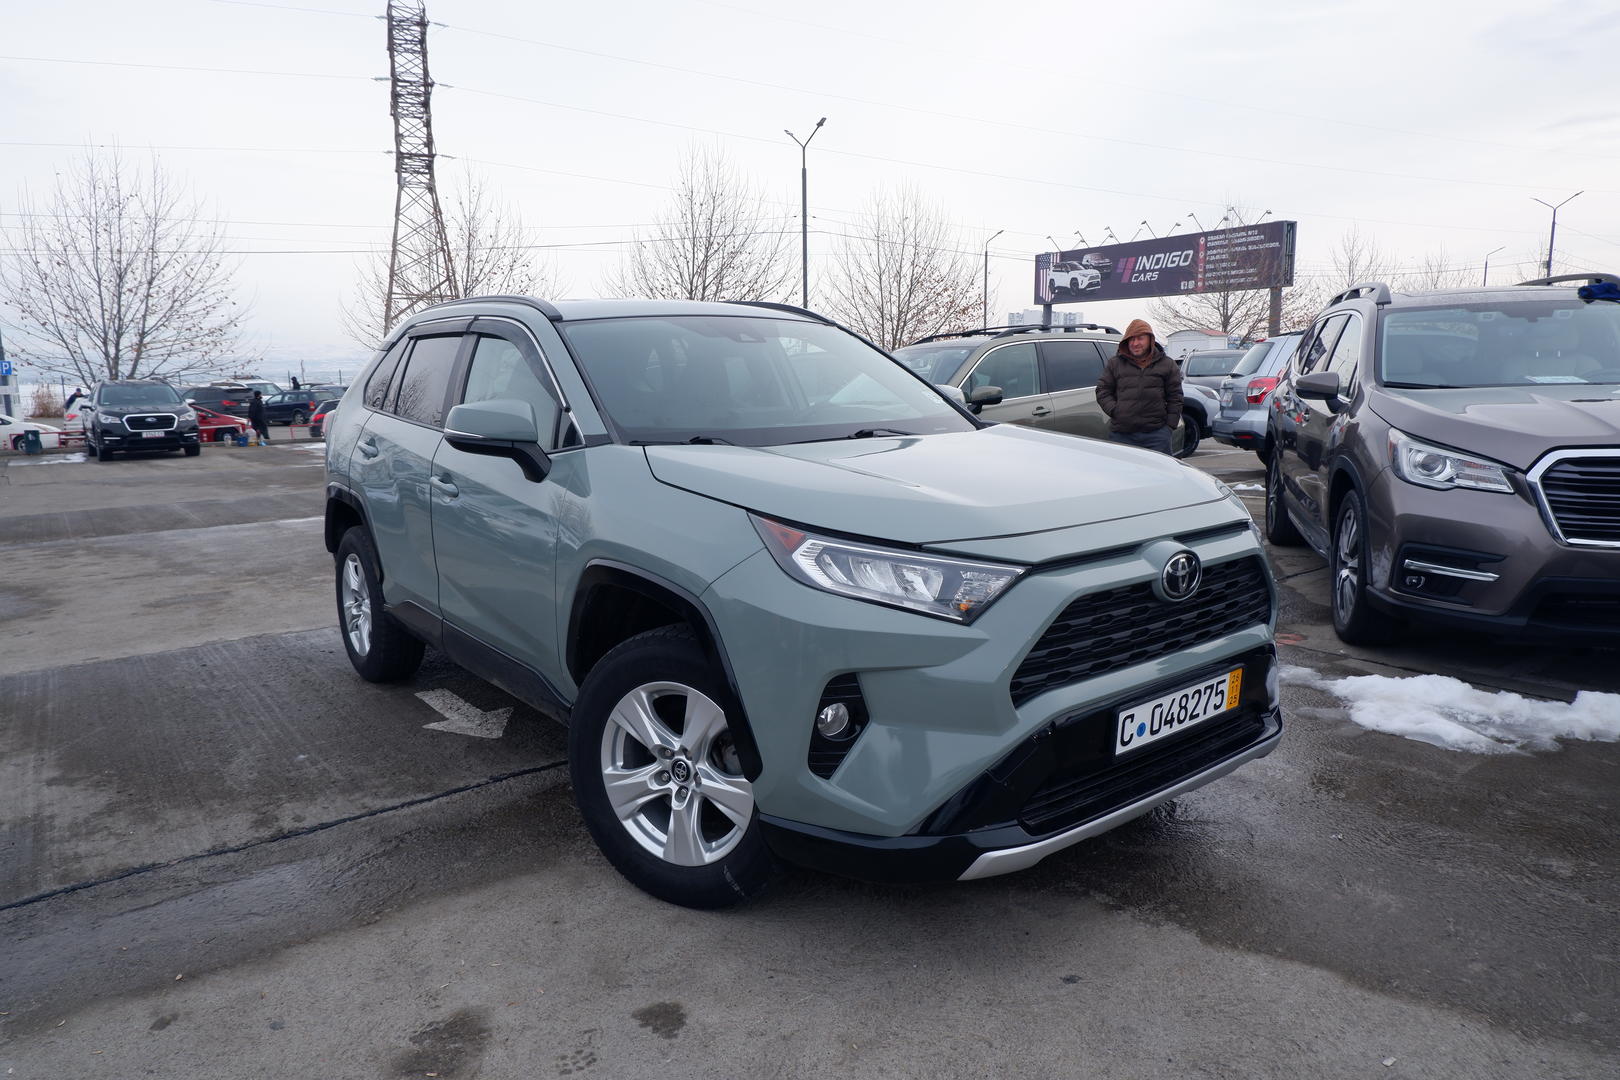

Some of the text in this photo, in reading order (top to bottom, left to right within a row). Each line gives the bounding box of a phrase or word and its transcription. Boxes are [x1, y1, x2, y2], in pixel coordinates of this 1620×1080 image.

[1135, 250, 1194, 271] INDIGO
[1131, 271, 1159, 283] CARS
[2, 362, 9, 374] P
[1120, 679, 1226, 747] C 048275
